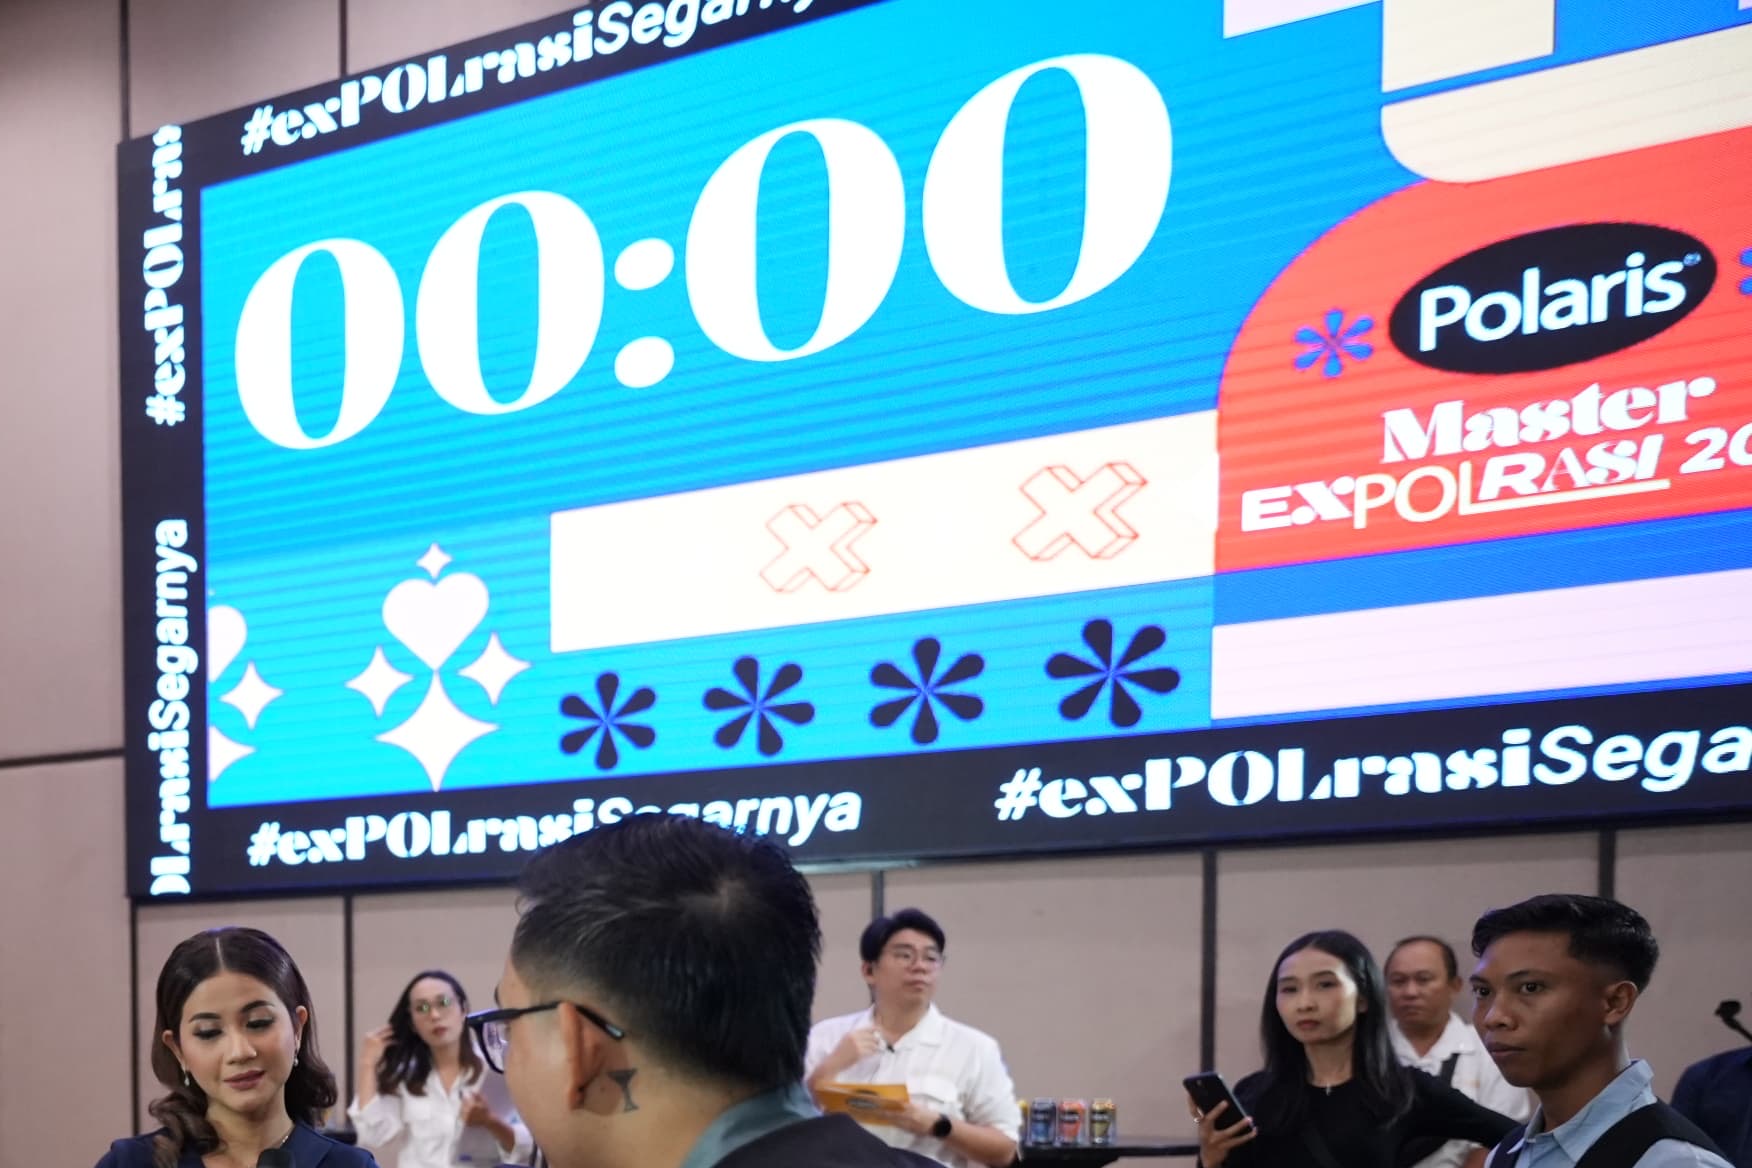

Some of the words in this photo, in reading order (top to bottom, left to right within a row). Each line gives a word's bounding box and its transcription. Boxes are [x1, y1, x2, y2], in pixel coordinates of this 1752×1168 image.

[240, 0, 815, 155] #exPOLrasiSega
[144, 123, 186, 426] #exPOLras
[234, 53, 1172, 449] 00:00
[1419, 251, 1688, 352] Polaris
[1381, 376, 1716, 463] Master
[1240, 433, 1671, 532] EXPOLRASI
[1678, 424, 1752, 475] 20
[994, 725, 1752, 822] #exPOLrasiSega
